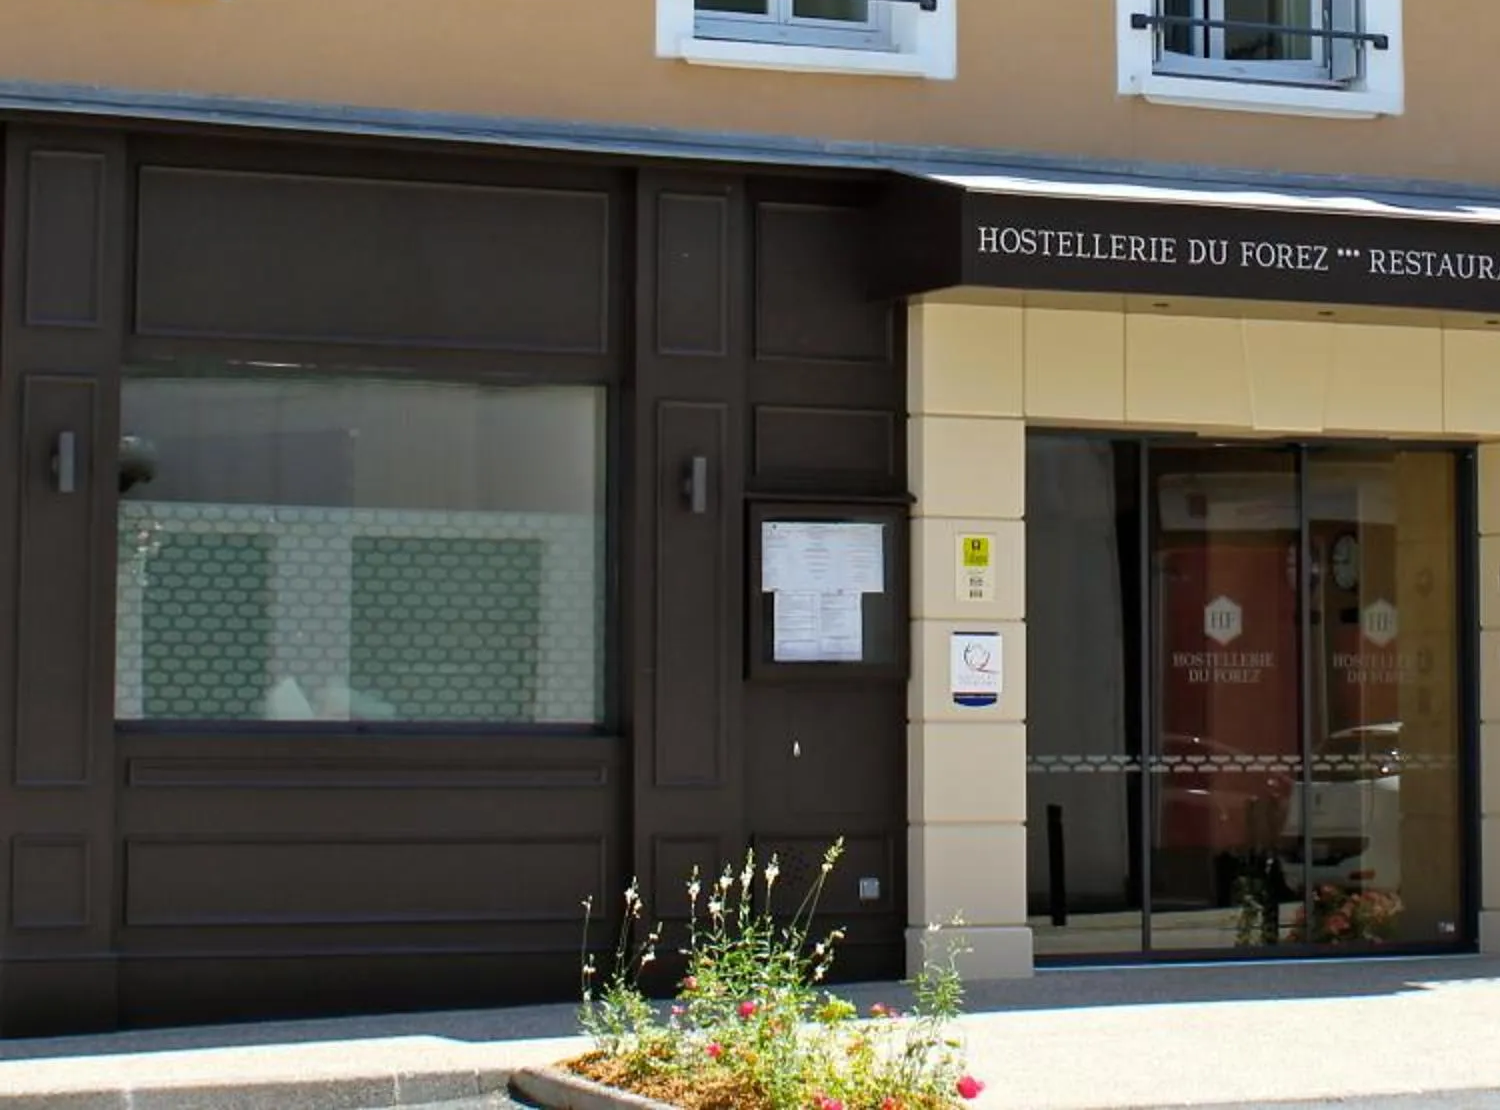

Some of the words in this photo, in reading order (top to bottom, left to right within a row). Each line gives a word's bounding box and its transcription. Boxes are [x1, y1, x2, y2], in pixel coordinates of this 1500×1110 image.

[977, 226, 1178, 264] HOSTELLERIE
[1188, 238, 1229, 266] DU
[1239, 241, 1330, 272] FOREZ
[1172, 651, 1275, 668] HOSTELLERIE
[1188, 668, 1209, 683] DU
[1213, 668, 1263, 683] FOREZ
